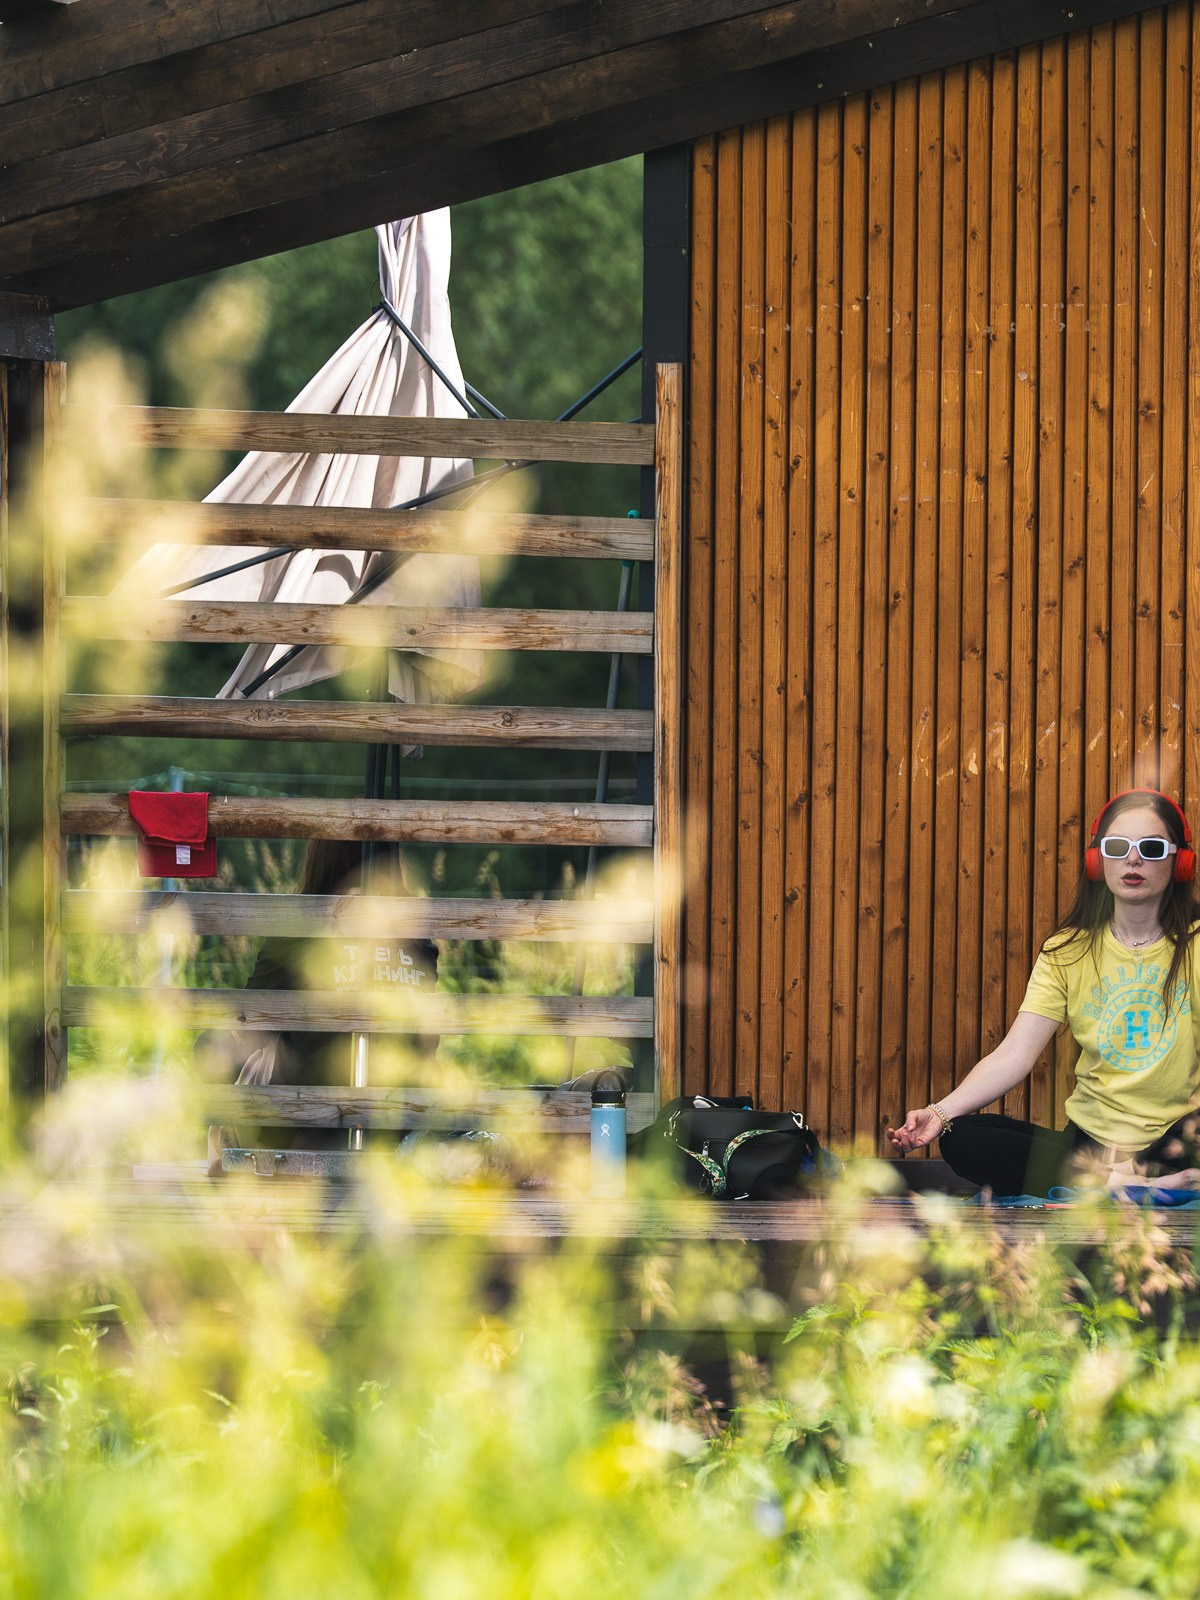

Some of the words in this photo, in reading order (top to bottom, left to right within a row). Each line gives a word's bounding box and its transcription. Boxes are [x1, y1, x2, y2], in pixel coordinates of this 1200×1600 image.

[343, 944, 414, 966] ТЕЬ
[332, 964, 426, 987] КЛНИНГ
[1122, 1010, 1152, 1051] H
